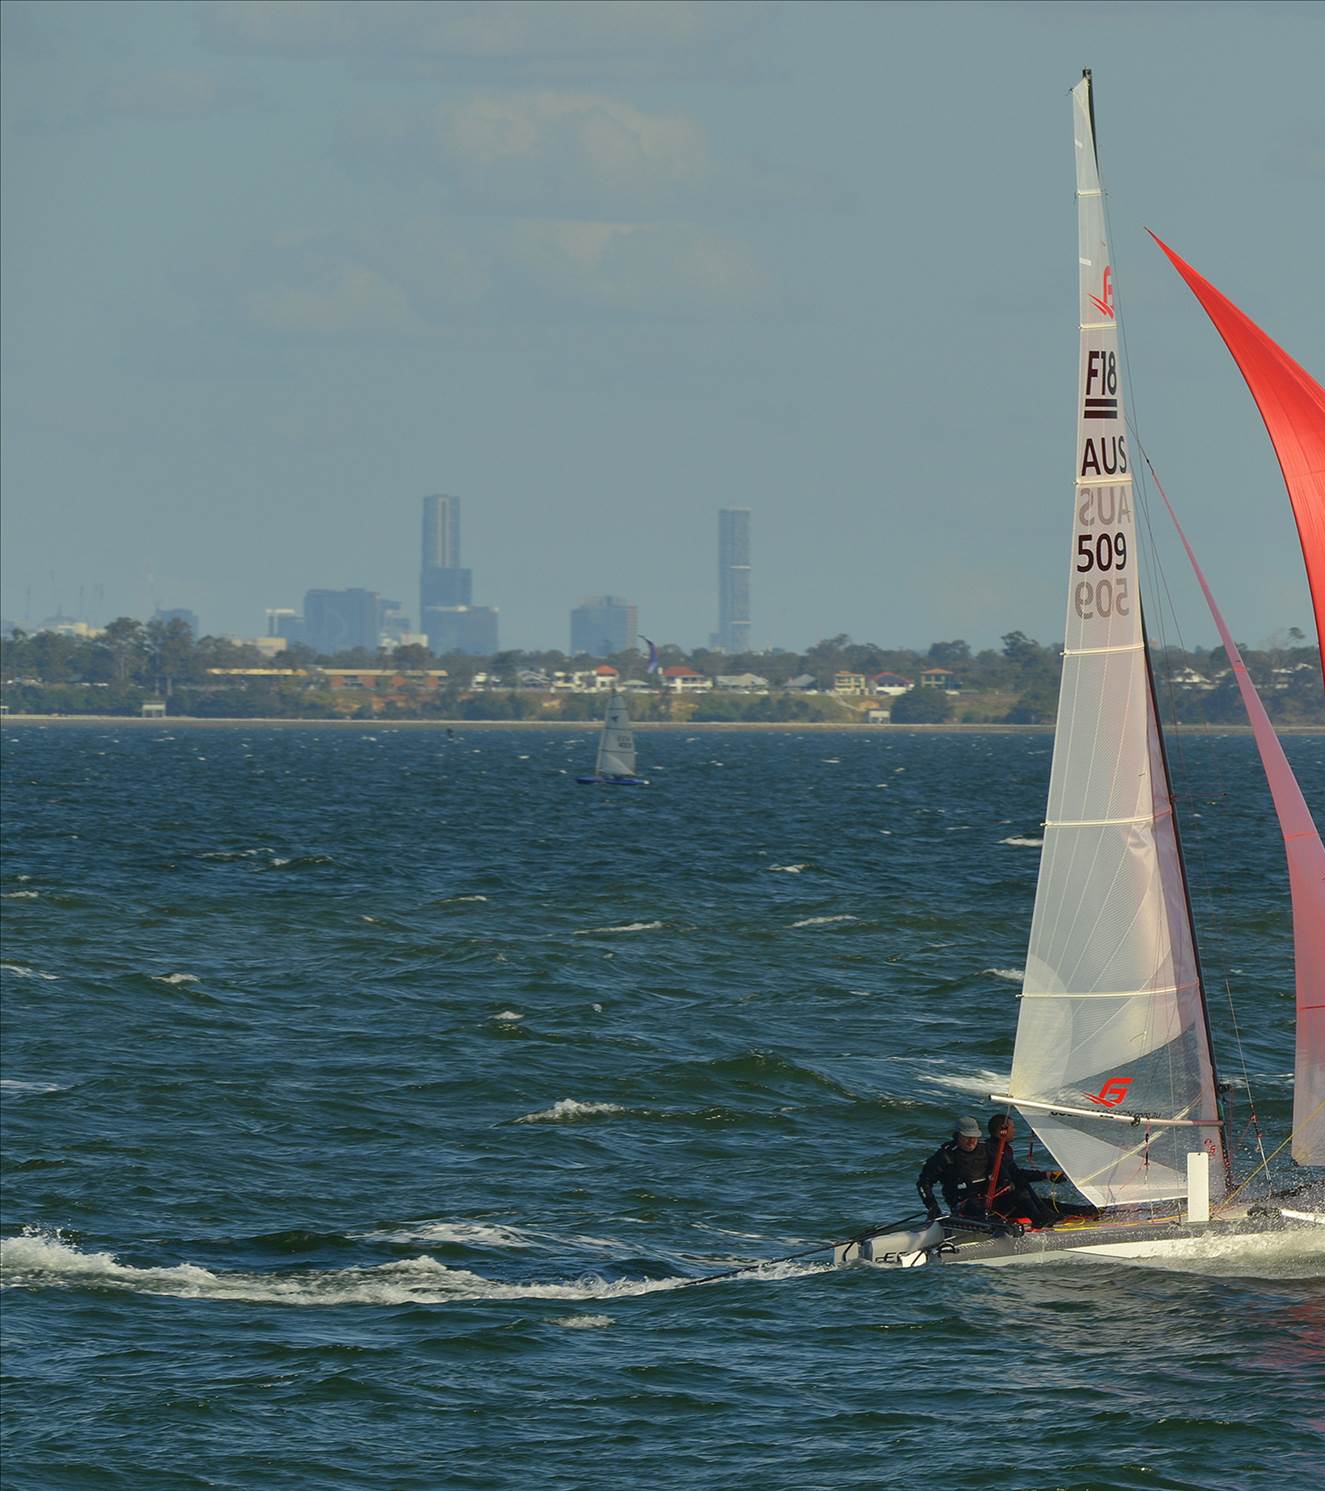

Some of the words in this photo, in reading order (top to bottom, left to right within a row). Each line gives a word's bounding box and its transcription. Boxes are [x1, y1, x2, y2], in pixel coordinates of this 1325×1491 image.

[1086, 351, 1117, 395] F18
[1081, 435, 1127, 476] AUS
[1077, 532, 1127, 572] 509
